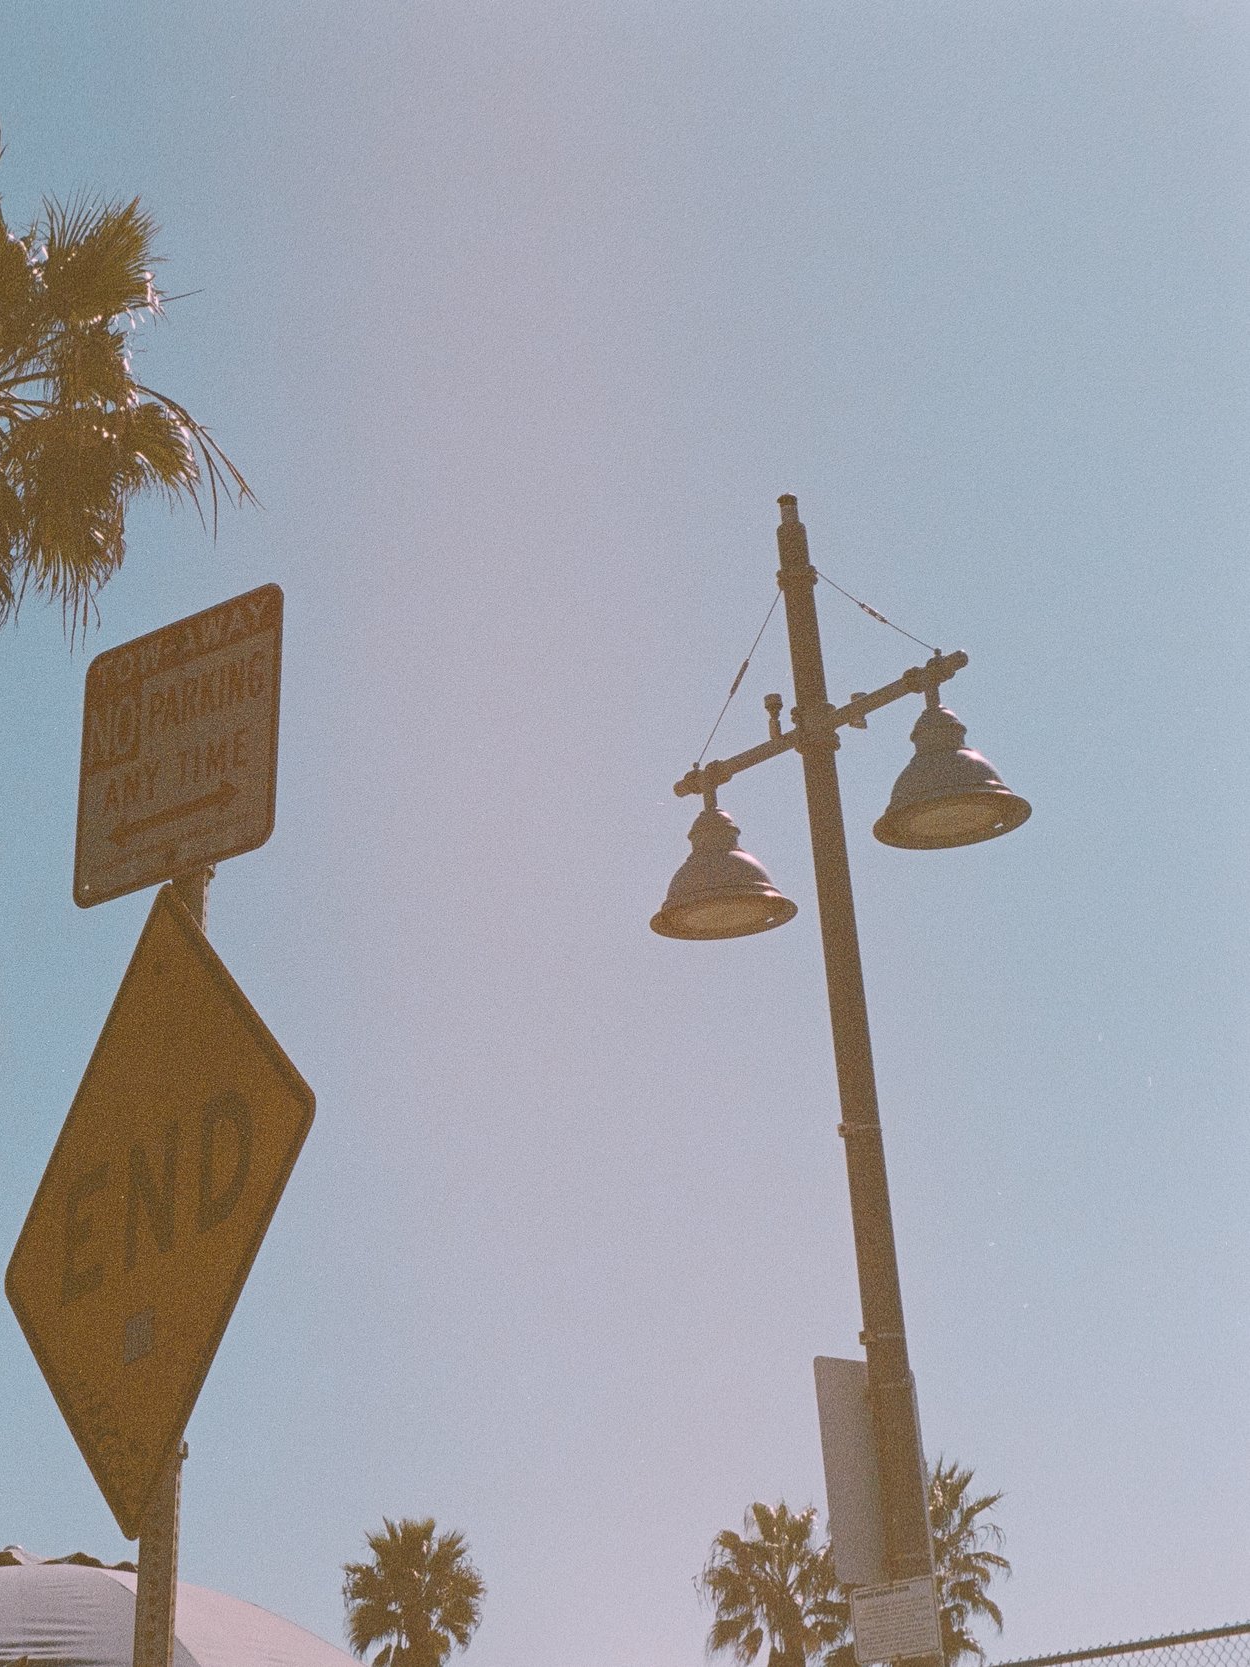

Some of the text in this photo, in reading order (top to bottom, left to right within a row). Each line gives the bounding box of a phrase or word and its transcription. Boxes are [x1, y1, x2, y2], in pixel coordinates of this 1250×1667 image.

[97, 595, 270, 692] TOW-AWAY
[86, 647, 267, 768] NO PARKING
[102, 725, 252, 818] ANY TIME
[61, 1088, 250, 1308] END
